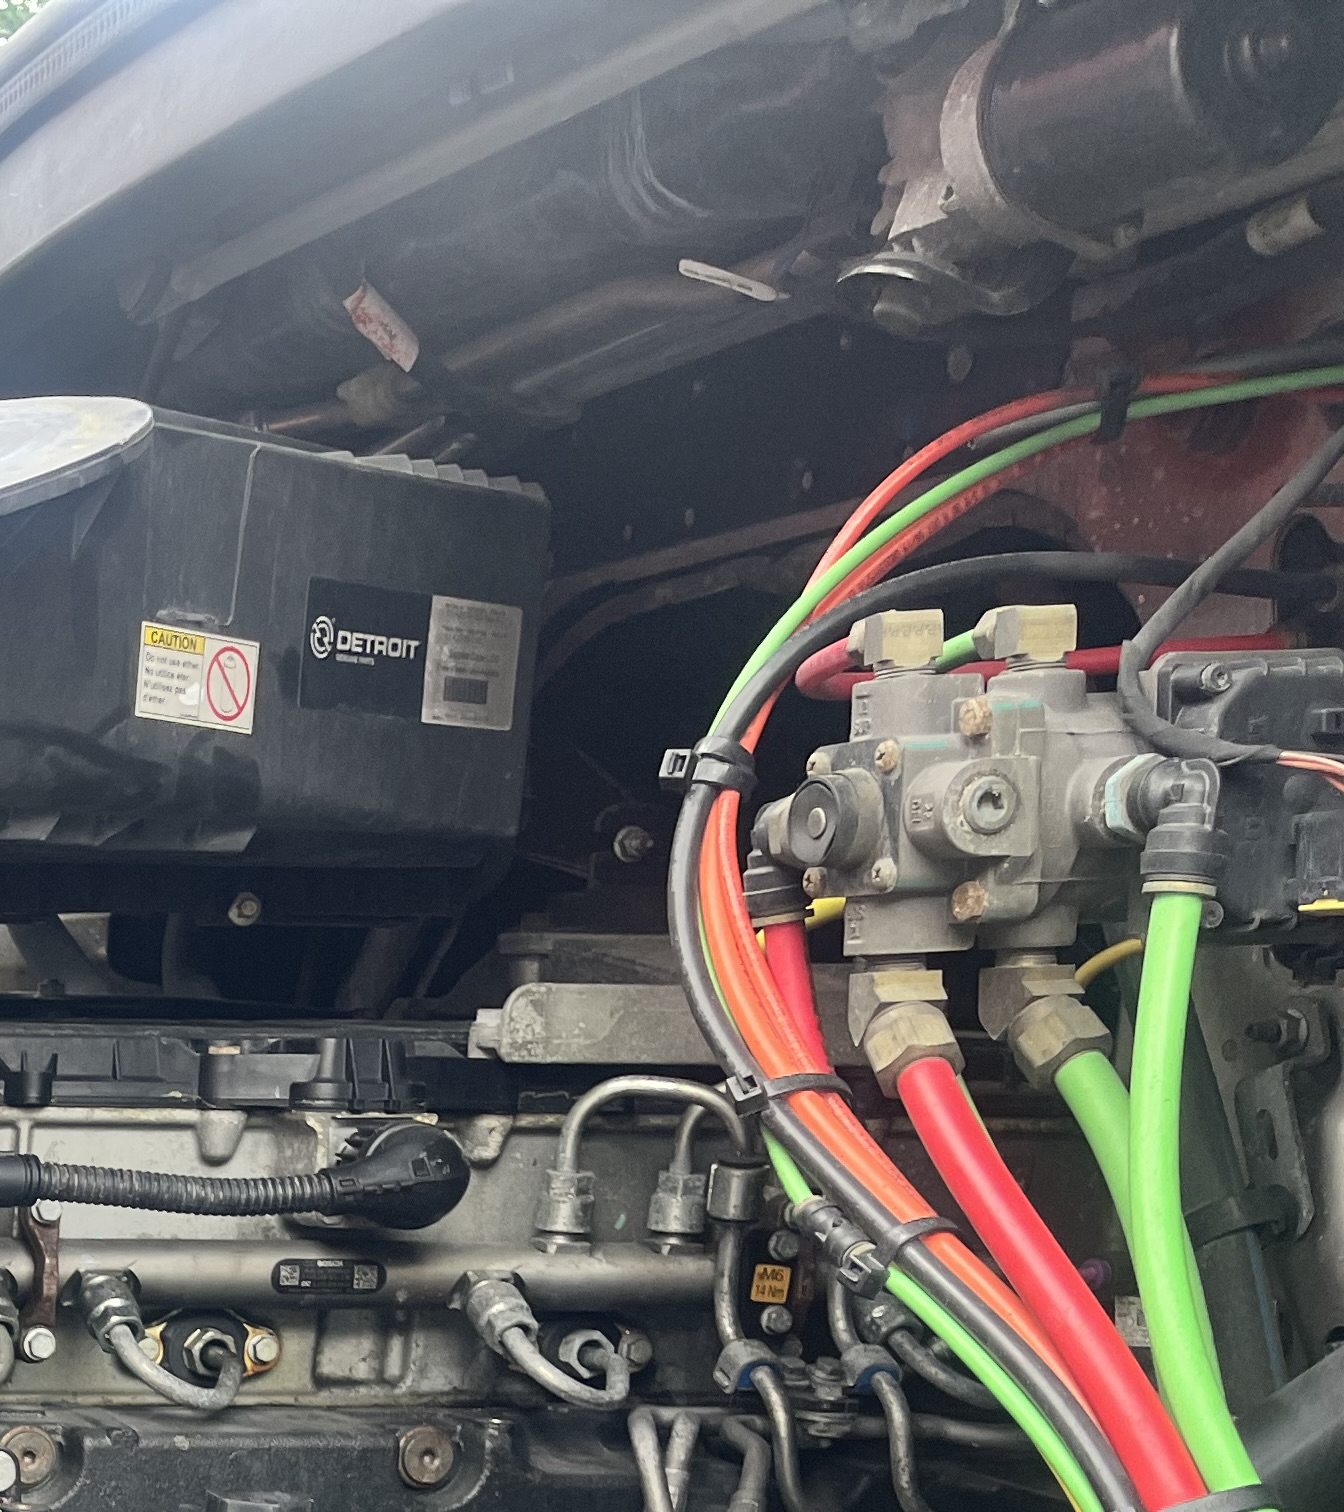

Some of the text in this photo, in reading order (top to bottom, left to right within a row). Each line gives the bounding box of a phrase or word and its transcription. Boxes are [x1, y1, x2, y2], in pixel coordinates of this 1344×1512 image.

[151, 631, 197, 650] CAUTION
[336, 630, 422, 659] DETROIT
[146, 652, 155, 662] Do
